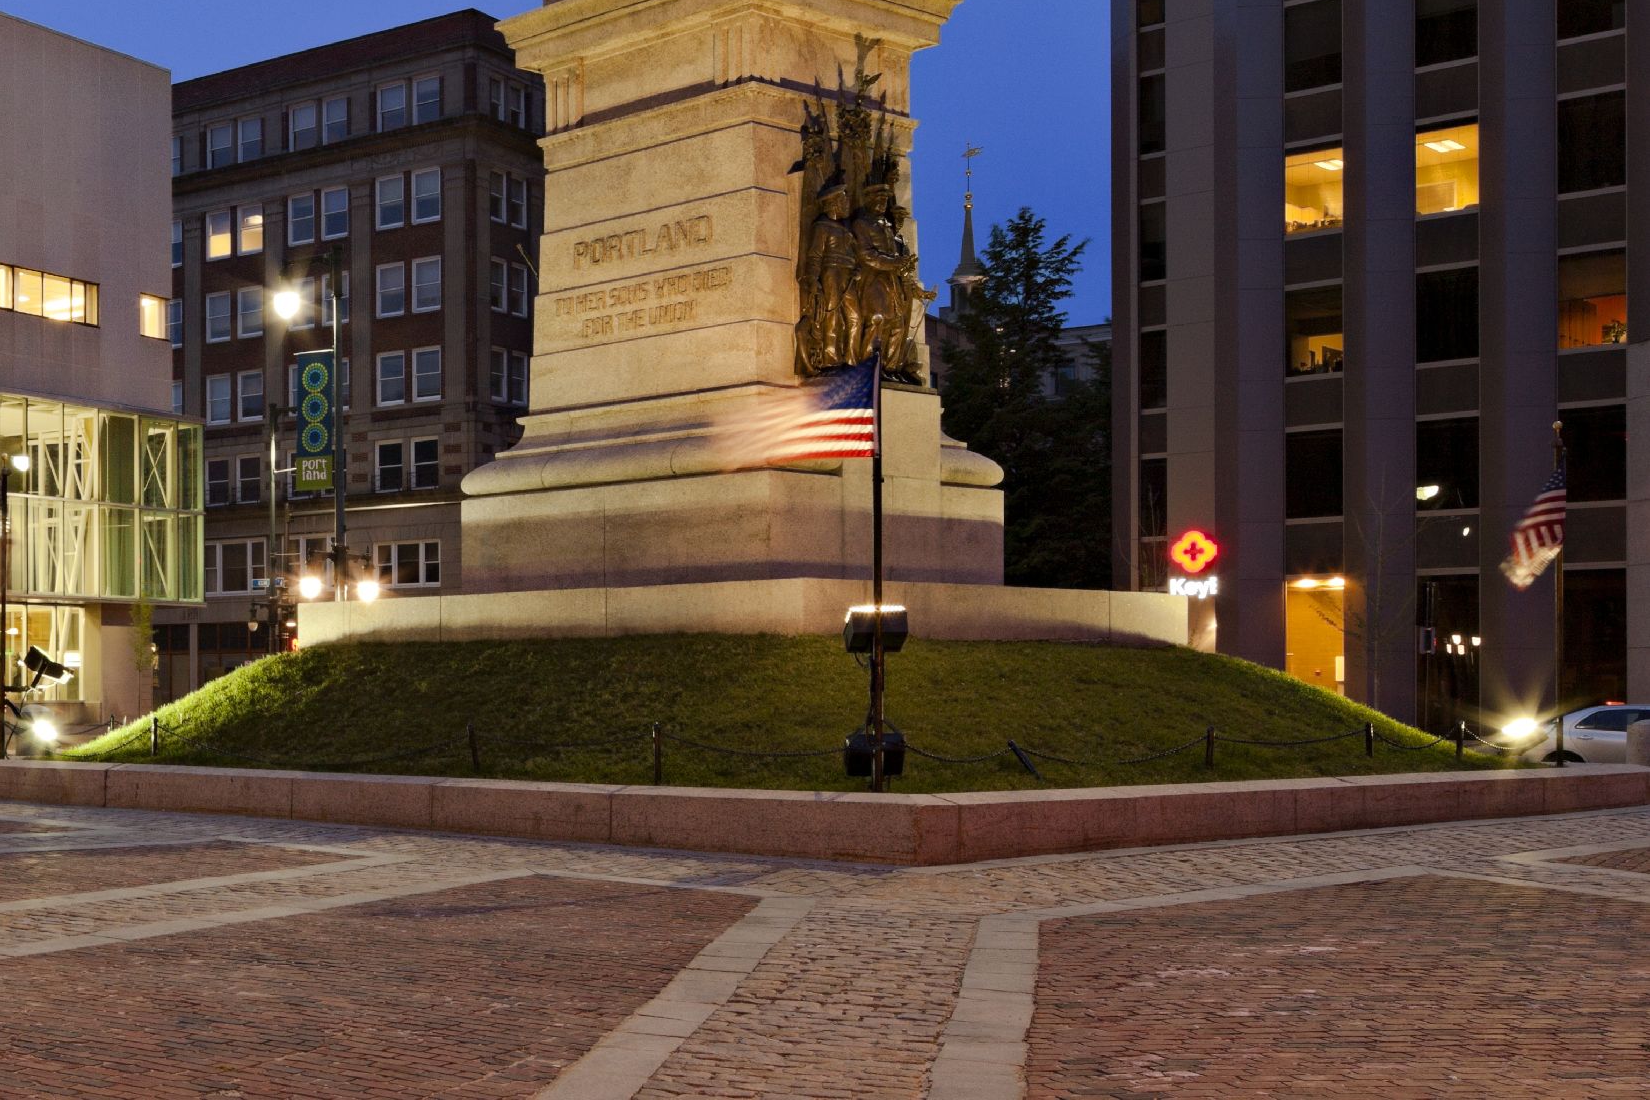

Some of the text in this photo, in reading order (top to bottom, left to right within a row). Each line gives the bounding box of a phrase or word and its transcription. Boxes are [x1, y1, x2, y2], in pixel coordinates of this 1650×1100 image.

[573, 214, 713, 270] PORTLAND
[555, 296, 574, 316] TO
[576, 291, 607, 314] HER
[609, 282, 648, 306] SONS
[653, 274, 691, 298] WHO
[582, 300, 698, 338] FOR THE UNION
[302, 467, 327, 482] land
